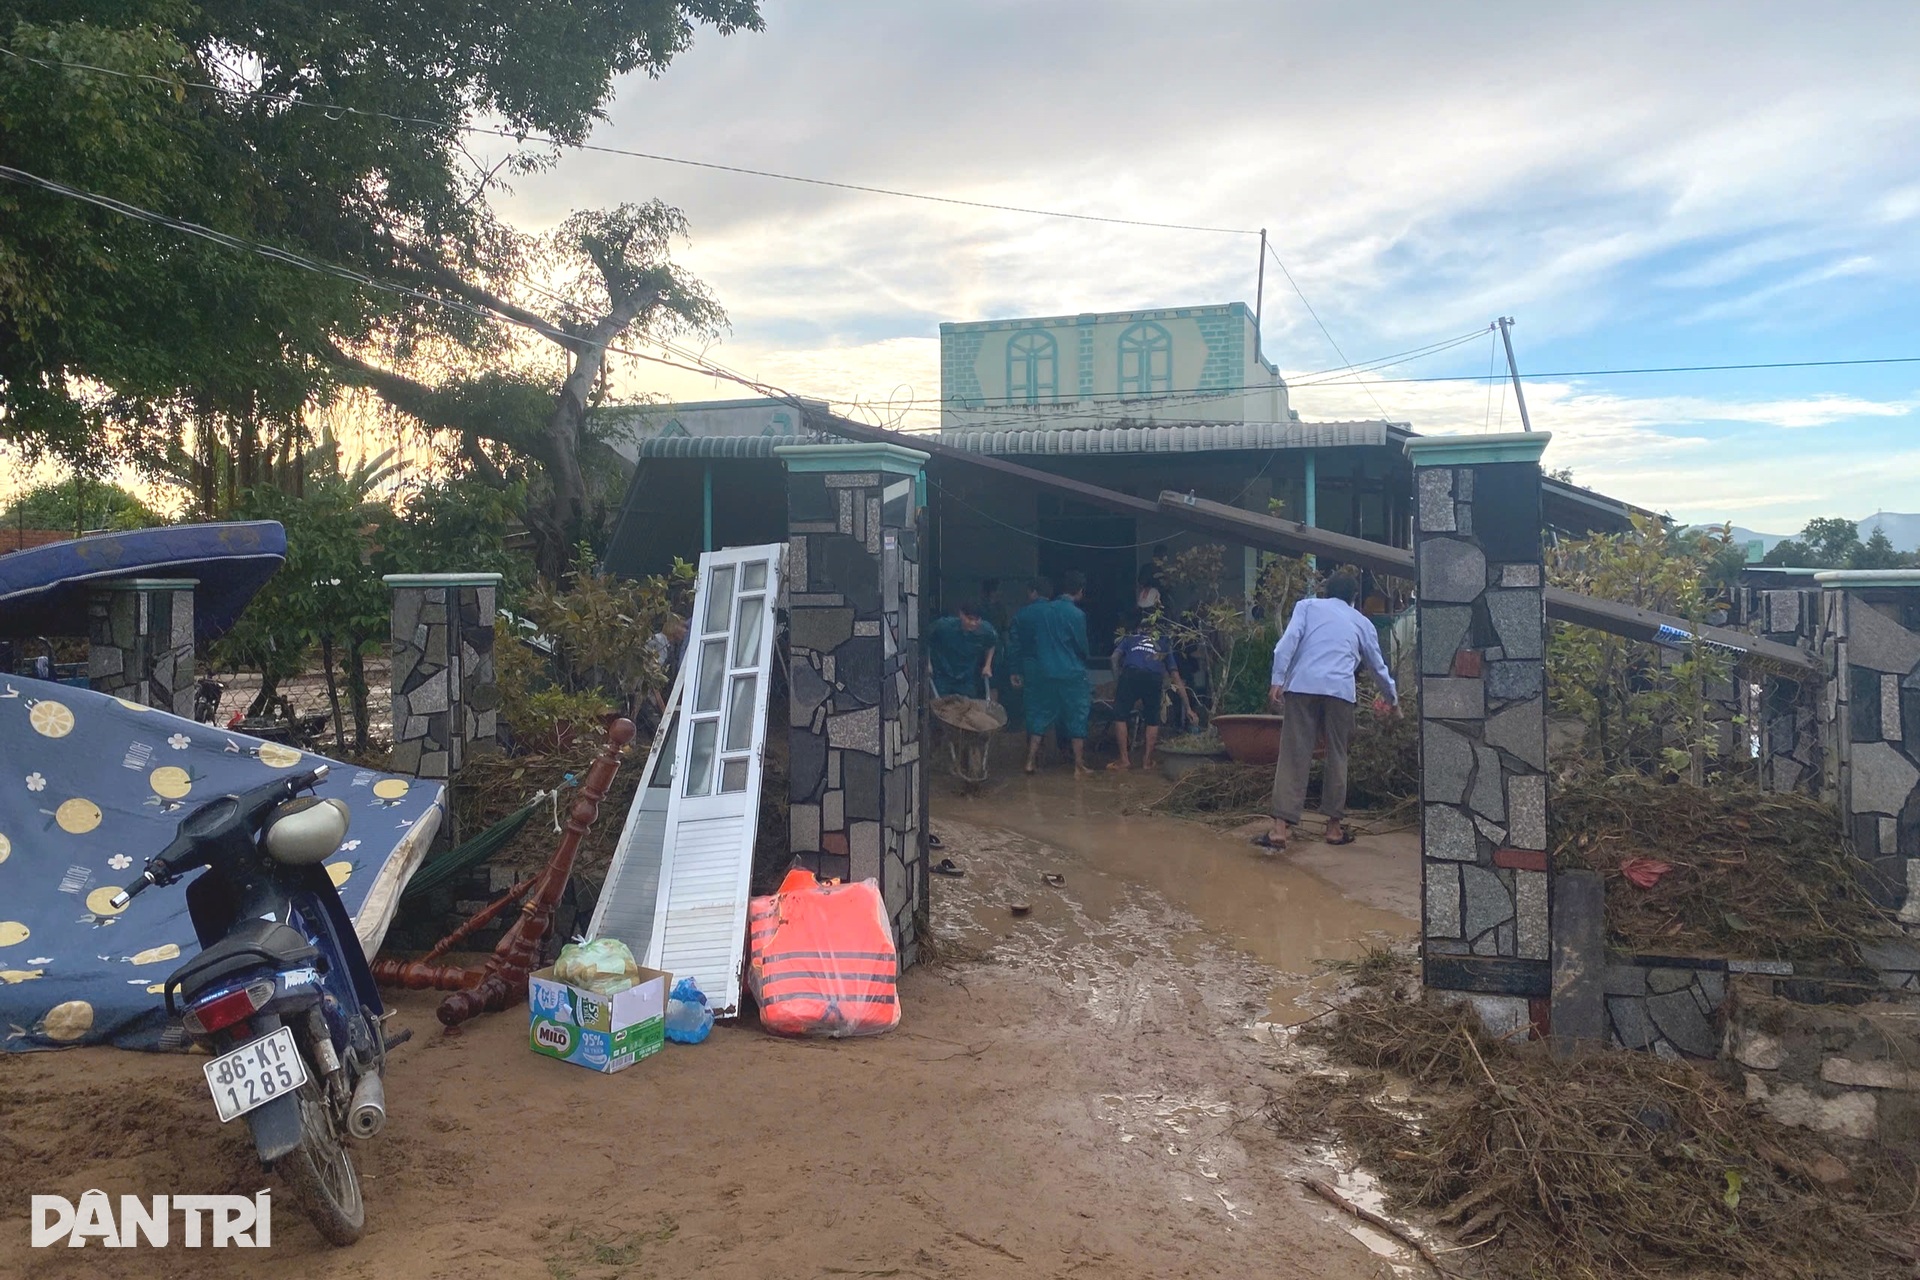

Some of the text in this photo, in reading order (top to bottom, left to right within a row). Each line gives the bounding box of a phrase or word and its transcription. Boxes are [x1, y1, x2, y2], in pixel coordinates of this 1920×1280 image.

[539, 1027, 567, 1046] MILO
[581, 1032, 604, 1047] 95%
[218, 1038, 281, 1085] 86-K1
[227, 1062, 293, 1111] 1285
